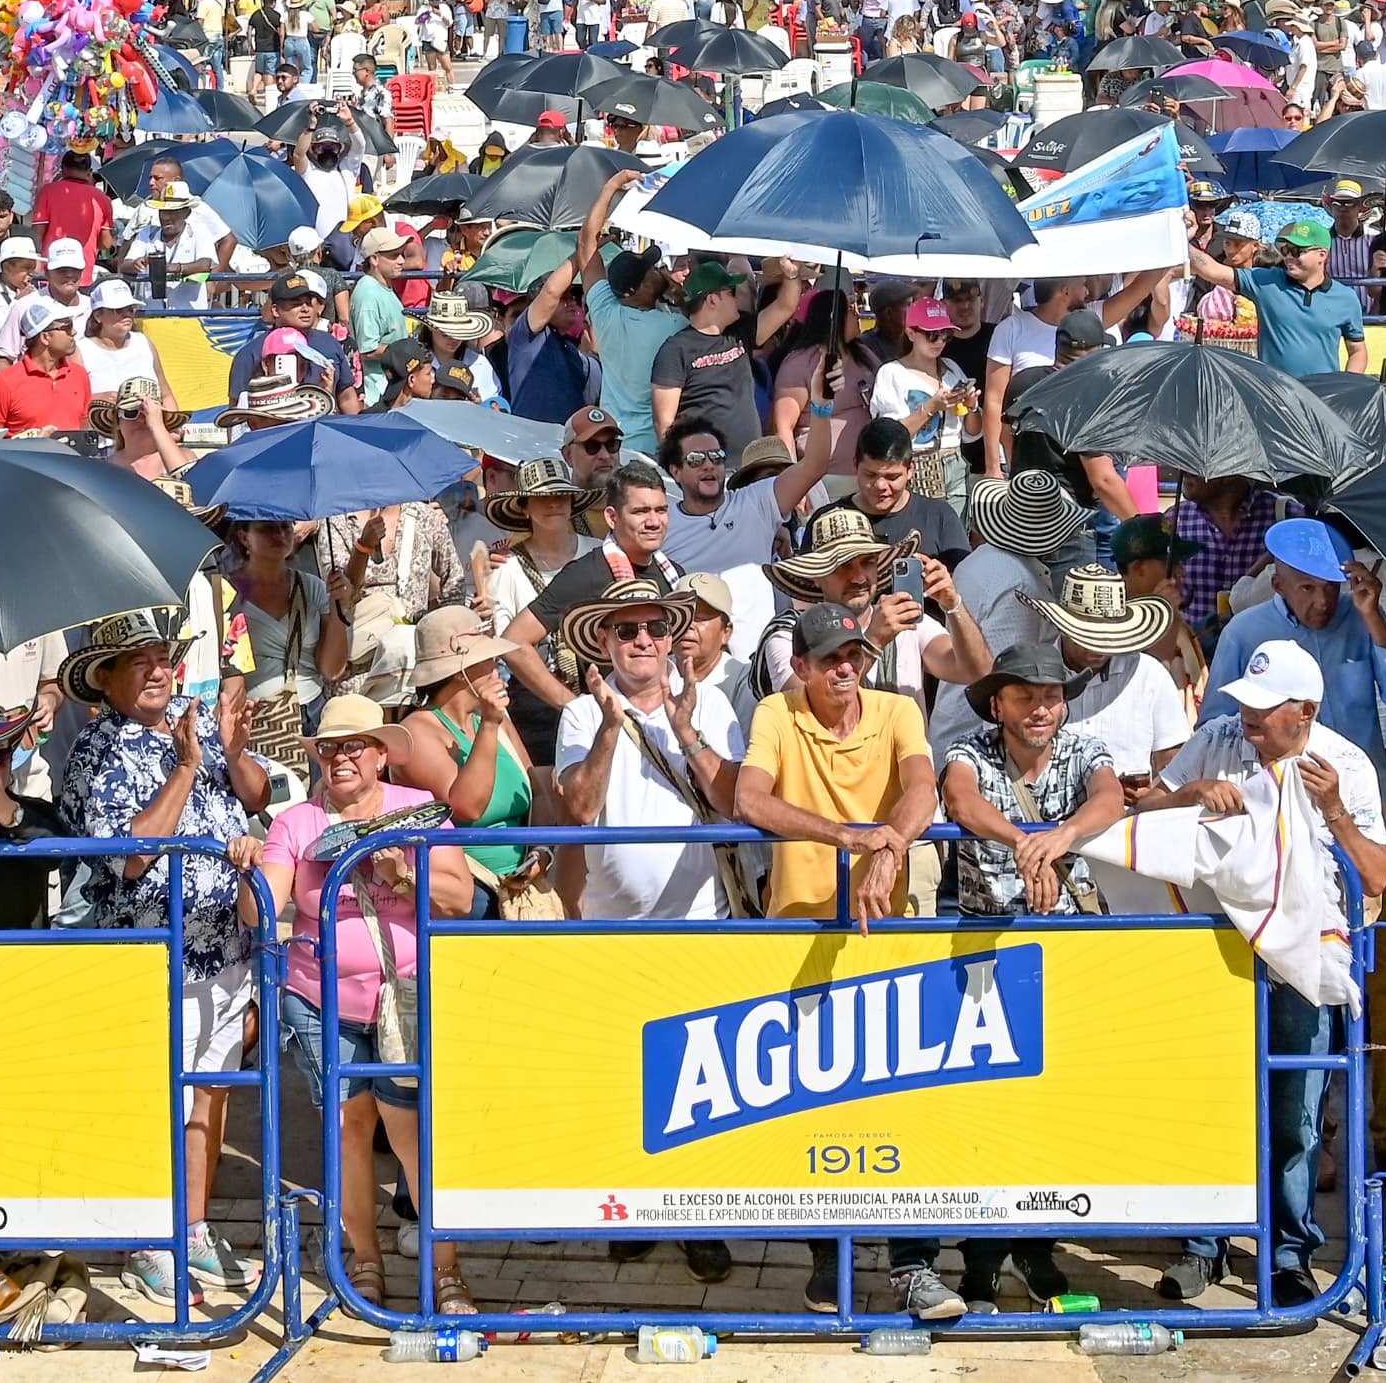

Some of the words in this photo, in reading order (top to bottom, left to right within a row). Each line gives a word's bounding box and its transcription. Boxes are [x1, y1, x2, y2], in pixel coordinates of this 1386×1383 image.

[663, 959, 1021, 1135] AGUILA
[806, 1144, 901, 1174] 1913
[663, 1194, 675, 1206] EL
[679, 1194, 723, 1206] EXCESO
[726, 1194, 740, 1206] DE
[744, 1193, 795, 1206] ALCOHOL
[799, 1193, 813, 1205] ES
[817, 1193, 887, 1205] PERJUDICIAL
[891, 1193, 920, 1205] PARA
[924, 1193, 938, 1205] LA
[941, 1193, 982, 1205] SALUD.
[1029, 1191, 1059, 1201] VIVE
[636, 1207, 691, 1221] PROHÍBESE
[695, 1208, 705, 1221] EL
[709, 1208, 759, 1221] EXPENDIO
[761, 1208, 774, 1220] DE
[777, 1208, 820, 1220] BEBIDAS
[822, 1207, 901, 1220] EMBRIAGANTES
[903, 1207, 910, 1220] A
[912, 1207, 961, 1220] MENORES
[964, 1207, 977, 1219] DE
[979, 1207, 1008, 1219] EDAD.
